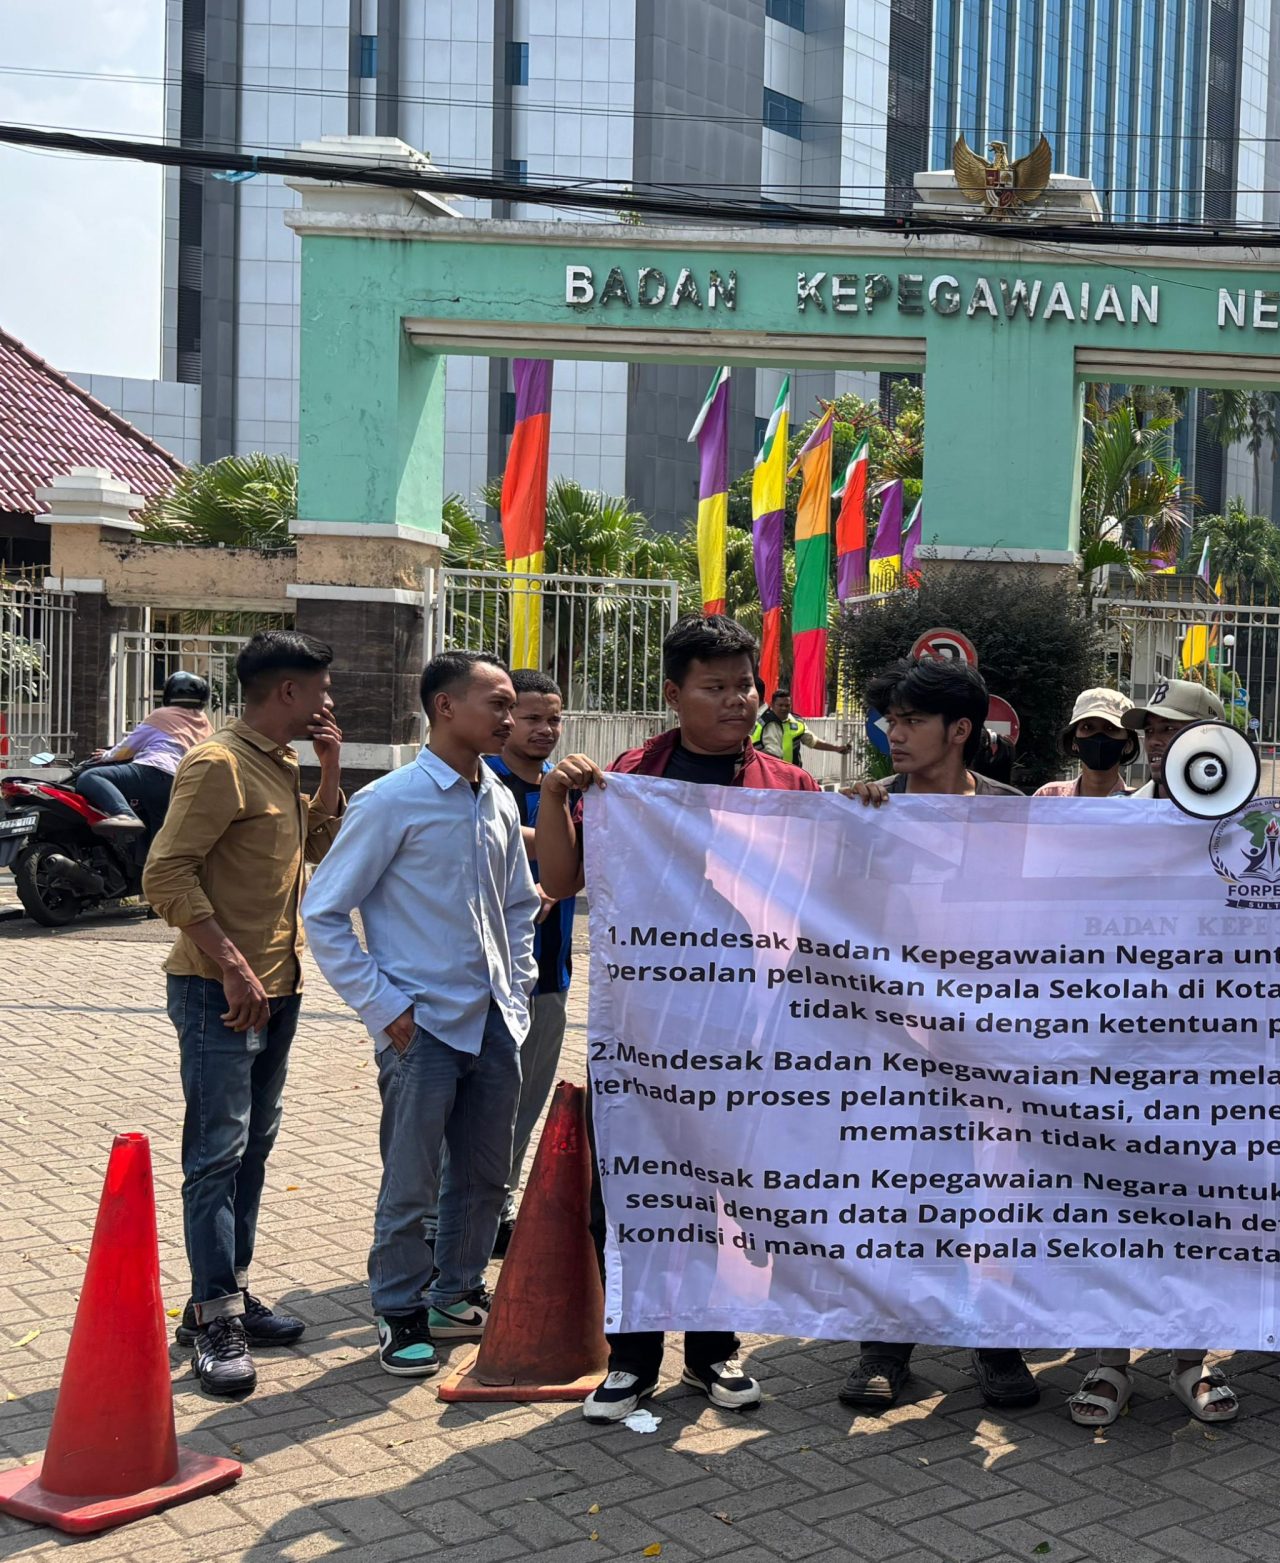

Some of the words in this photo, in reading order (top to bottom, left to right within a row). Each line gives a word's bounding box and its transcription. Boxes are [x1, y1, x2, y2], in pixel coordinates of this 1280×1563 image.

[565, 265, 738, 311] BADAN
[797, 271, 1159, 324] KEPEGAWAIAN
[1151, 683, 1169, 705] B
[1084, 917, 1178, 936] BADAN
[608, 925, 790, 951] 1.Mendesak
[796, 937, 890, 961] Badan
[901, 944, 1105, 971] Kepegawaian
[1116, 945, 1224, 971] Negara
[606, 961, 756, 983] persoalan
[767, 965, 926, 998] pelantikan
[936, 978, 1039, 1004] Kepala
[1049, 978, 1168, 999] Sekolah
[1178, 978, 1205, 1000] di
[788, 998, 869, 1021] tidak
[874, 1009, 965, 1032] sesuai
[975, 1012, 1089, 1040] dengan
[1099, 1013, 1258, 1034] ketentuan
[590, 1041, 764, 1072] 2.Mendesak
[774, 1050, 872, 1071] Badan
[883, 1052, 1079, 1085] Kepegawaian
[1090, 1066, 1199, 1091] Negara
[593, 1076, 716, 1112] terhadap
[726, 1090, 831, 1112] proses
[840, 1085, 1013, 1114] pelantikan,
[1021, 1099, 1133, 1124] mutasi,
[1143, 1099, 1200, 1121] dan
[839, 1120, 1032, 1143] memastikan
[1040, 1128, 1118, 1152] tidak
[1125, 1134, 1237, 1162] adanya
[763, 1168, 860, 1190] Badan
[871, 1168, 1073, 1195] Kepegawaian
[1083, 1172, 1188, 1198] Negara
[625, 1193, 716, 1214] sesuai
[722, 1199, 829, 1229] dengan
[838, 1203, 907, 1224] data
[918, 1202, 1044, 1230] Dapodik
[1052, 1202, 1108, 1224] dan
[1117, 1206, 1232, 1231] sekolah
[618, 1222, 724, 1245] kondisi
[732, 1231, 756, 1252] di
[764, 1239, 845, 1260] mana
[855, 1238, 924, 1259] data
[935, 1237, 1037, 1264] Kepala
[1046, 1237, 1164, 1259] Sekolah
